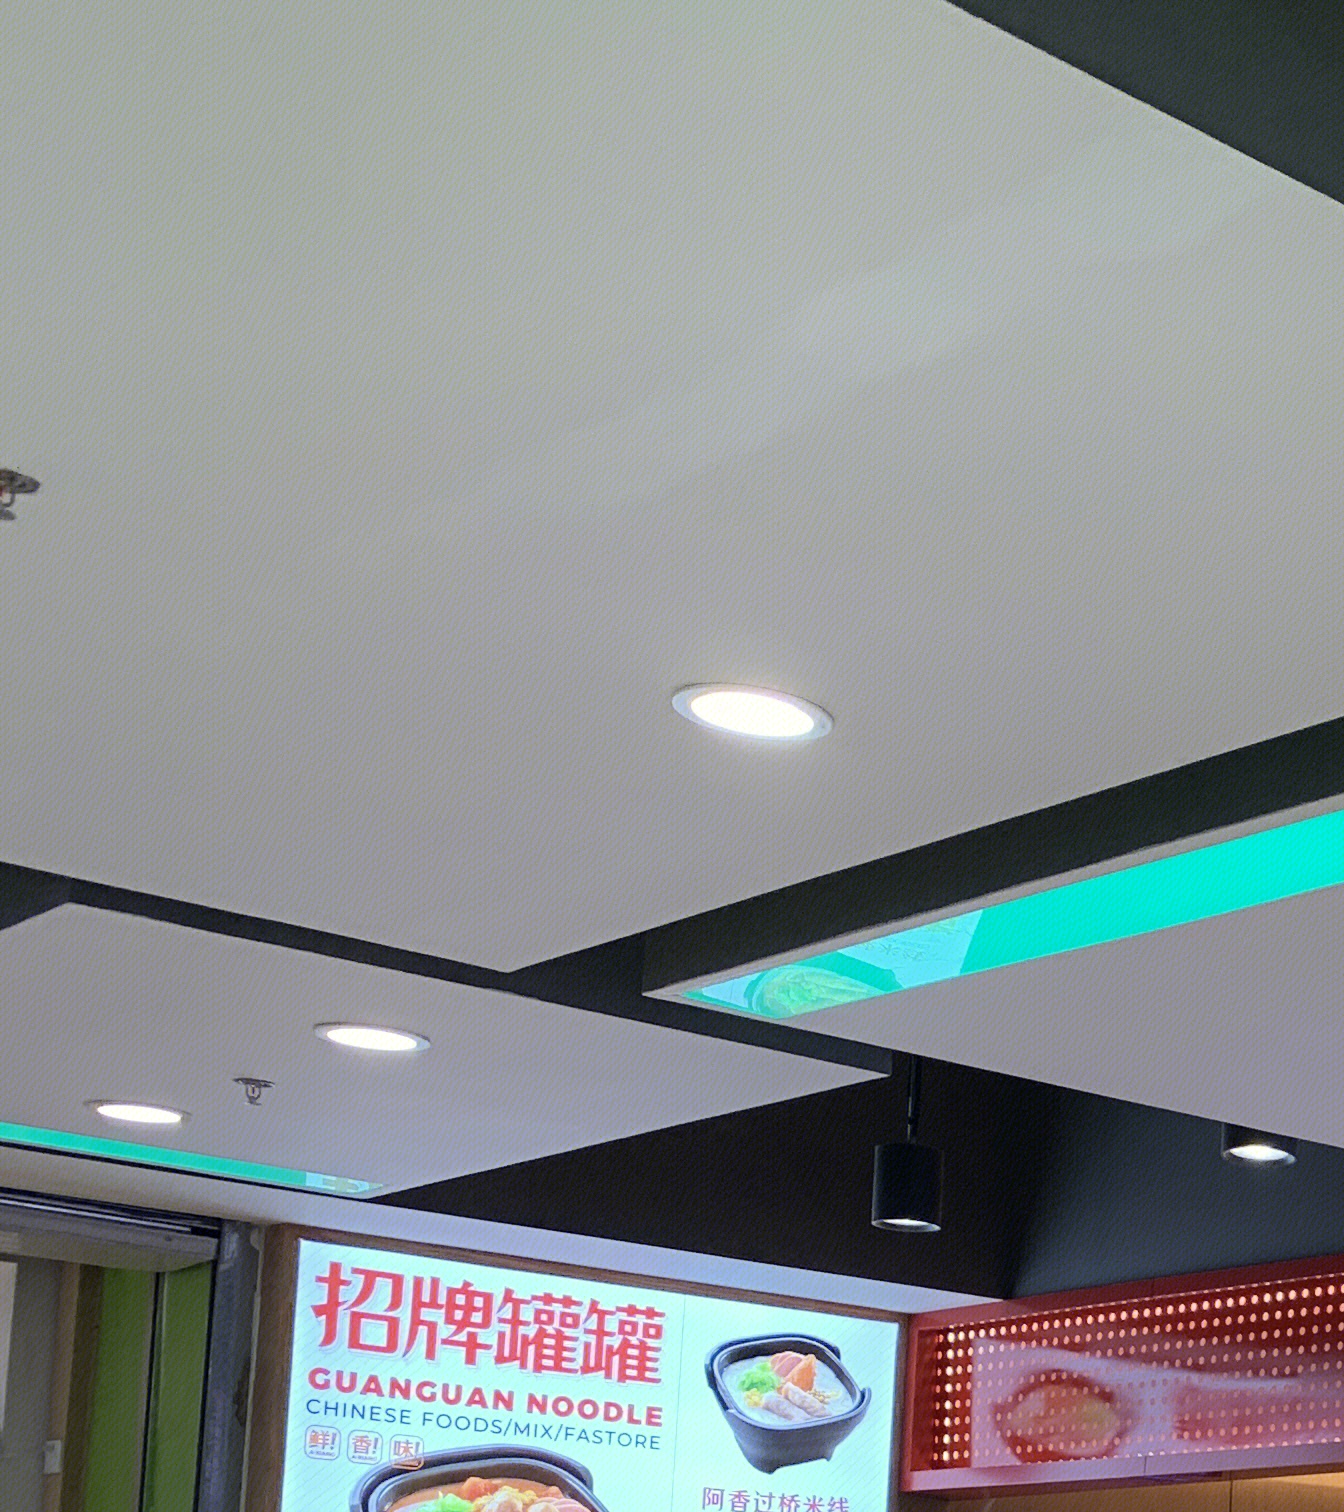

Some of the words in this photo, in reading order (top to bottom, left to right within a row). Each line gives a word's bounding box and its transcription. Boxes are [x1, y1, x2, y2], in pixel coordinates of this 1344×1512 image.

[310, 1261, 666, 1384] 招牌罐罐
[306, 1399, 412, 1425] CHINESE
[422, 1412, 661, 1450] FOODS/MIX/FASTORE
[307, 1367, 514, 1411] GUANGUAN
[527, 1393, 663, 1427] NOODLE
